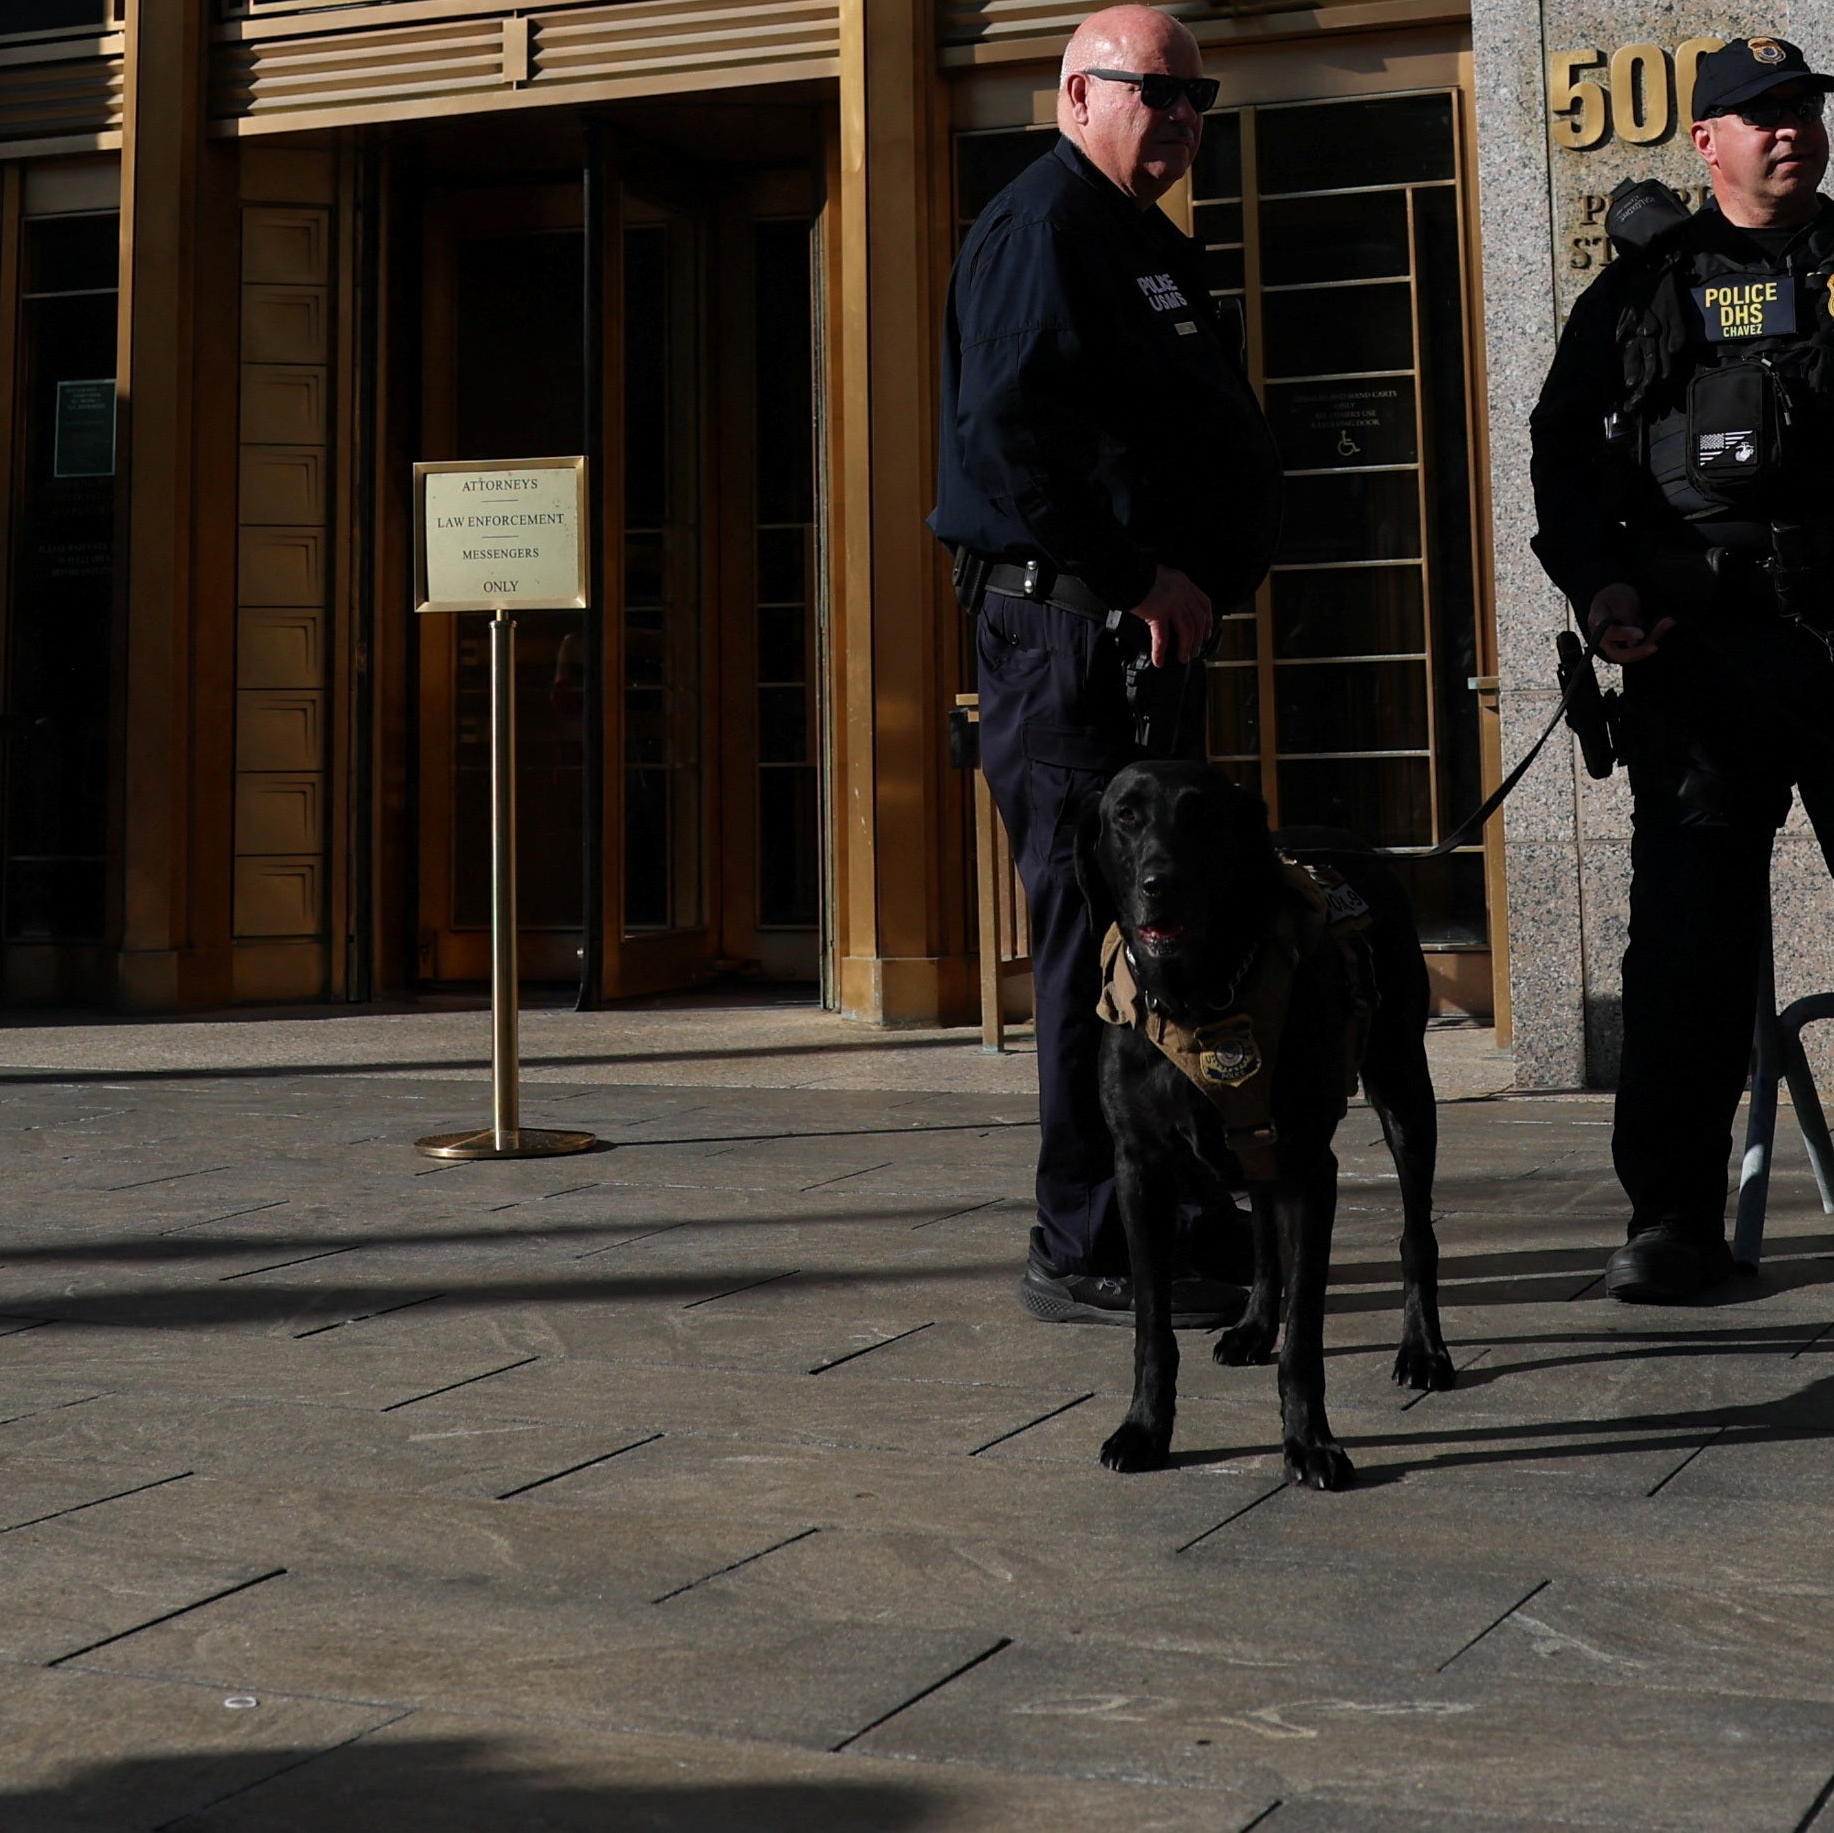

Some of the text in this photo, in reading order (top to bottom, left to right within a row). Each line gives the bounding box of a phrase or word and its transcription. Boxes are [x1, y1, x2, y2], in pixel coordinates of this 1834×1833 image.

[1136, 273, 1178, 296] POLICE
[1148, 291, 1188, 312] USMS
[1705, 282, 1778, 308] POLICE
[1720, 303, 1764, 326] DHS
[1723, 323, 1763, 338] CHAVEZ
[462, 478, 538, 492] ATTORNEYS
[437, 513, 565, 528] LAW ENFORCEMENT
[462, 548, 539, 560] MESSENGERS
[483, 580, 519, 593] ONLY
